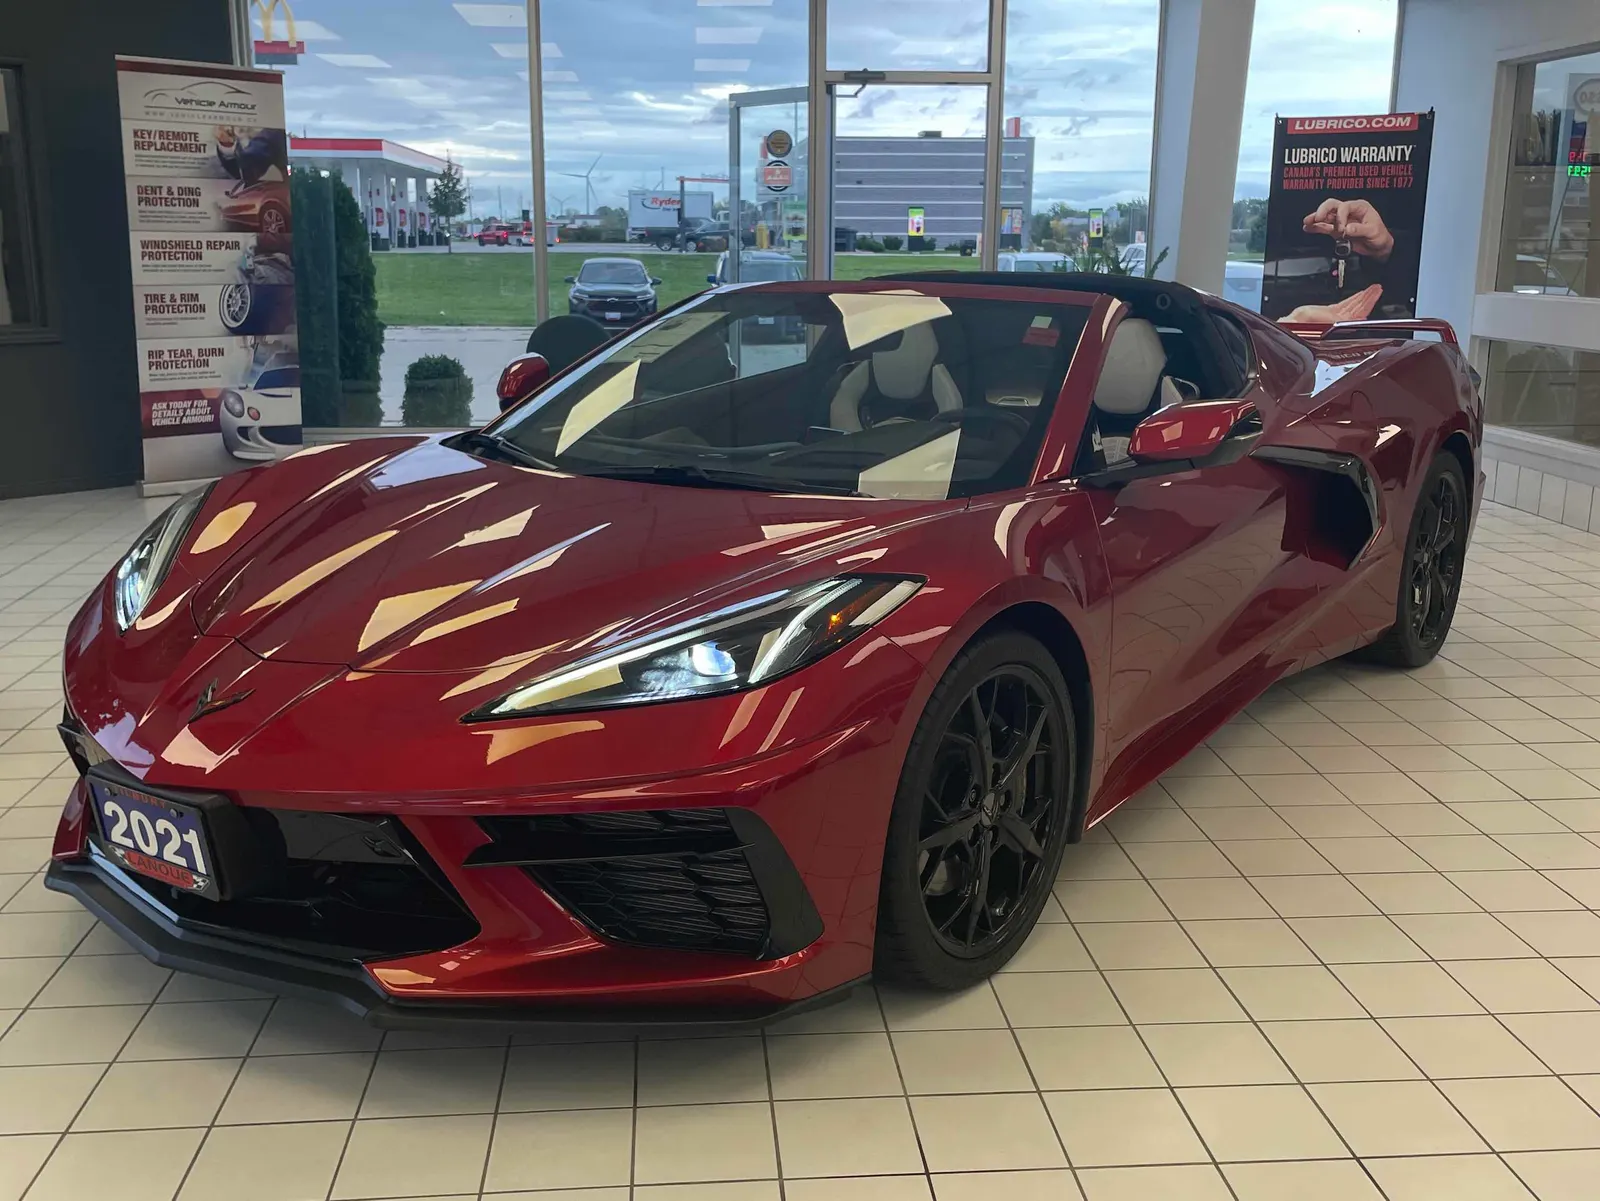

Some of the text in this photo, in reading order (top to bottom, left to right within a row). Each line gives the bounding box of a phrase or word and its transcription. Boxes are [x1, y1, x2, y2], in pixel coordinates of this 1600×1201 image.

[174, 97, 257, 110] Vehicle Armour
[1294, 117, 1412, 130] LUBRICO.COM
[133, 141, 207, 153] REPLACEMENT
[1284, 145, 1412, 164] LUBRICO WARRANTY
[1283, 164, 1413, 178] CANADA'S PREMIER USED VEHICLE
[1283, 178, 1324, 190] WARRANTY
[1327, 177, 1364, 189] PROVIDER
[1366, 177, 1389, 189] SINCE
[136, 185, 201, 197] DENT & DING
[137, 196, 199, 208] PROTECTION
[140, 240, 240, 251] WINDSHIELD REPAIR
[141, 250, 203, 261] PROTECTION
[144, 293, 199, 304] TIRE & RIM
[144, 304, 206, 314] PROTECTION
[197, 347, 224, 357] BURN
[148, 358, 209, 370] PROTECTION
[152, 399, 208, 410] ASK TODAY FOR
[152, 406, 211, 418] DETAILS ABOUT
[152, 414, 214, 426] VEHICLE ARMOUR!
[103, 800, 207, 875] 2021
[126, 850, 192, 884] LANOUE
